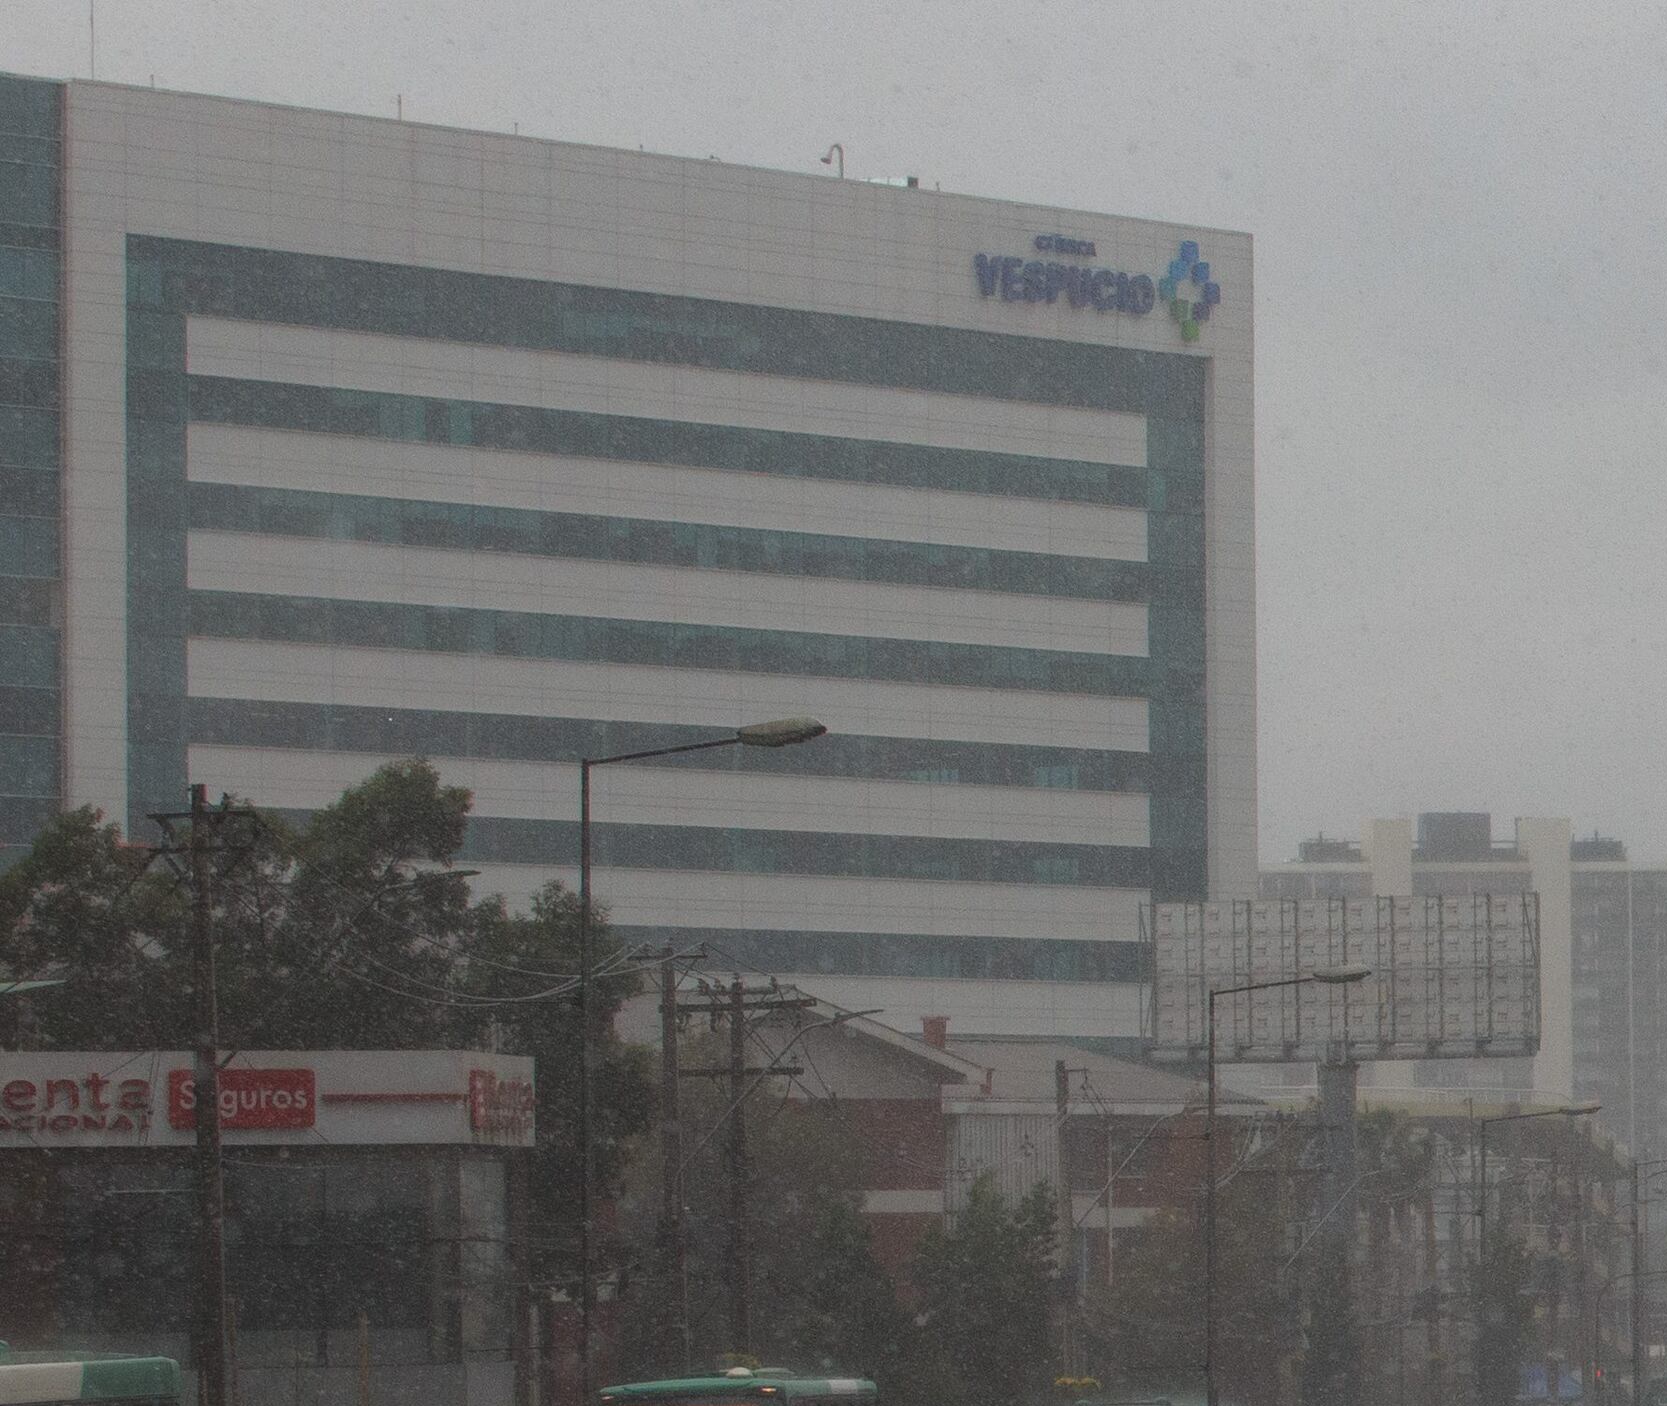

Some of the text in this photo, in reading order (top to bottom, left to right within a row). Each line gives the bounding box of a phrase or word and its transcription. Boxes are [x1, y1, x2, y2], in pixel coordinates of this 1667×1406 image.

[974, 252, 1155, 317] VESPUCIO
[2, 1072, 309, 1119] enta Sguros
